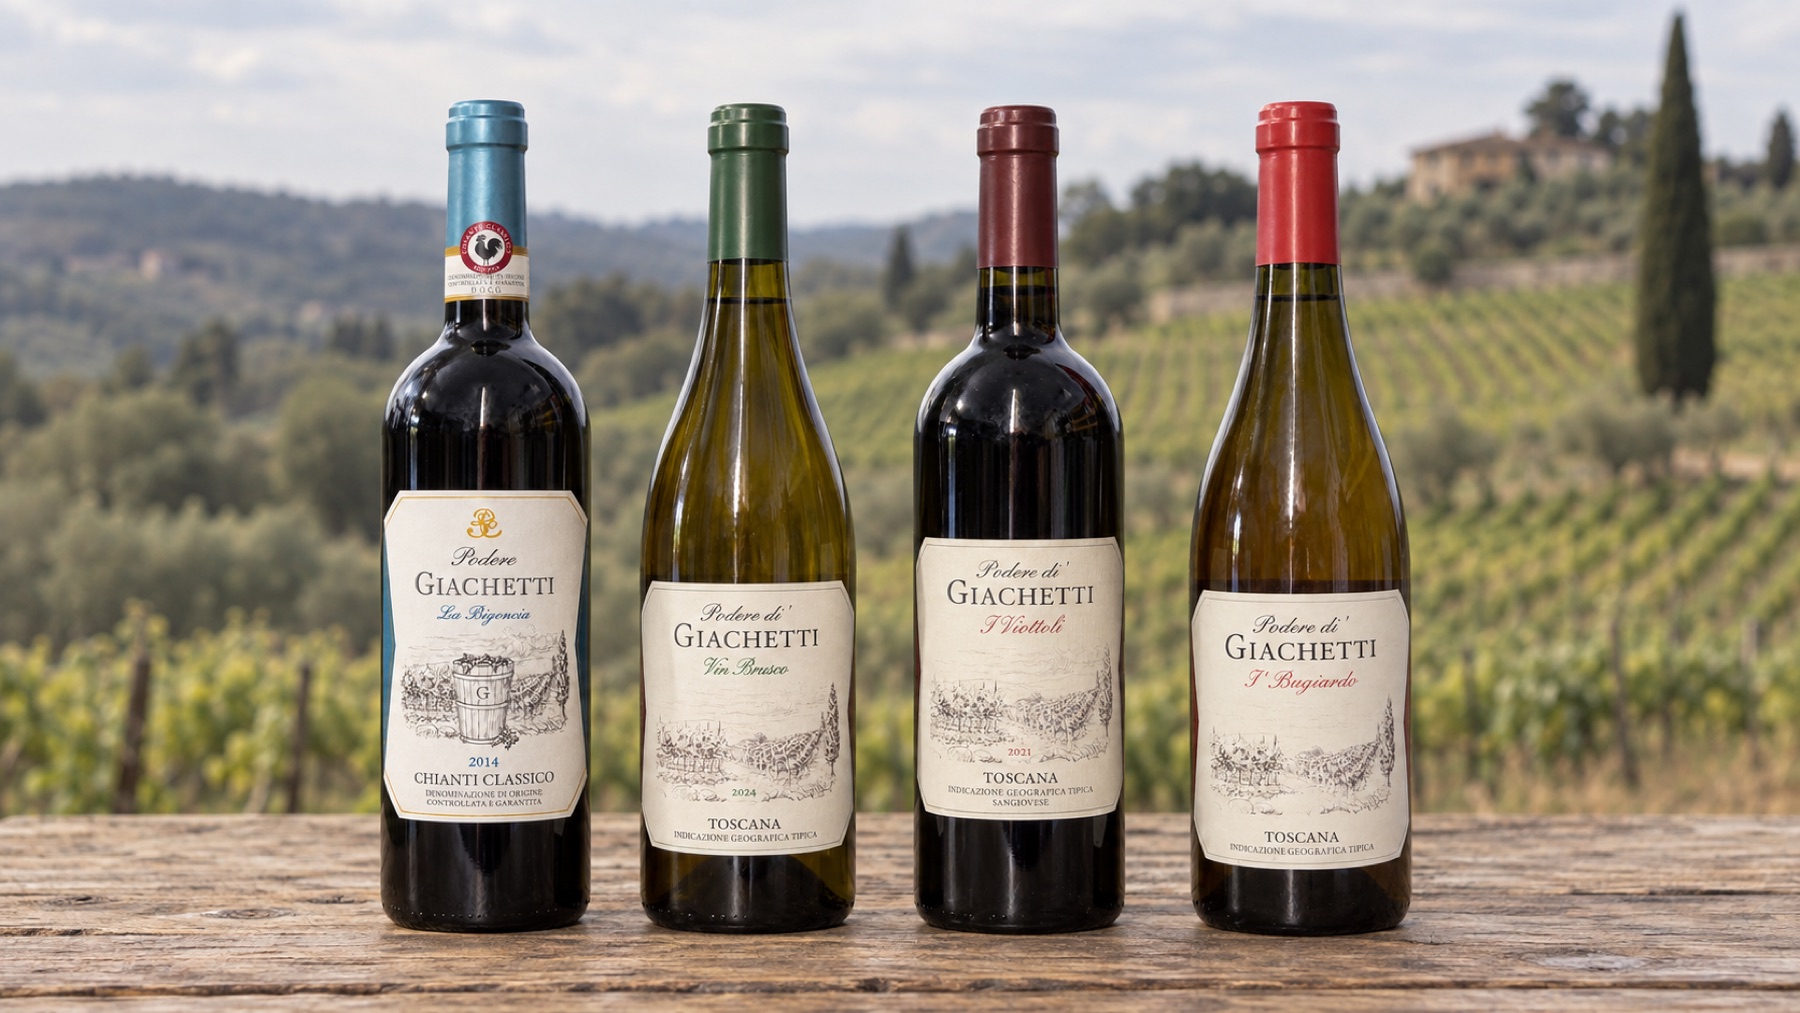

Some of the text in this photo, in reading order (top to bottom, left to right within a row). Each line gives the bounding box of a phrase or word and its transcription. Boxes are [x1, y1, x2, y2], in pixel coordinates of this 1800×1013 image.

[451, 546, 517, 566] Podere
[976, 559, 1038, 579] Podere
[415, 571, 554, 596] GIACHETTI
[946, 578, 1094, 606] GIACHETTI
[437, 605, 462, 620] La
[700, 602, 760, 622] Podere
[1000, 613, 1066, 634] Viottoli
[1252, 614, 1316, 634] Podere
[674, 622, 819, 649] GIACHETTI
[1225, 633, 1377, 661] GIACHETTI
[703, 657, 789, 676] Vin Brusco
[1268, 669, 1358, 696] Bugiardo
[476, 686, 490, 700] G
[1007, 748, 1032, 757] 2021
[468, 757, 499, 767] 2014
[414, 771, 555, 786] CHIANTI CLASSICO
[982, 772, 1059, 785] TOSCANA
[497, 789, 507, 798] DI
[510, 788, 543, 798] ORIGINE
[731, 788, 757, 797] 2024
[948, 785, 1004, 796] INDICAZIONE
[1067, 785, 1094, 795] TIPICA
[426, 799, 486, 808] CONTROLLATA
[992, 798, 1050, 807] SANGIOVESE
[707, 818, 782, 830] TOSCANA
[674, 830, 729, 842] INDICAZIONE
[791, 831, 818, 841] TIPICA
[1264, 831, 1340, 844] TOSCANA
[1230, 843, 1286, 856] INDICAZIONE
[1349, 843, 1375, 854] TIPICA
